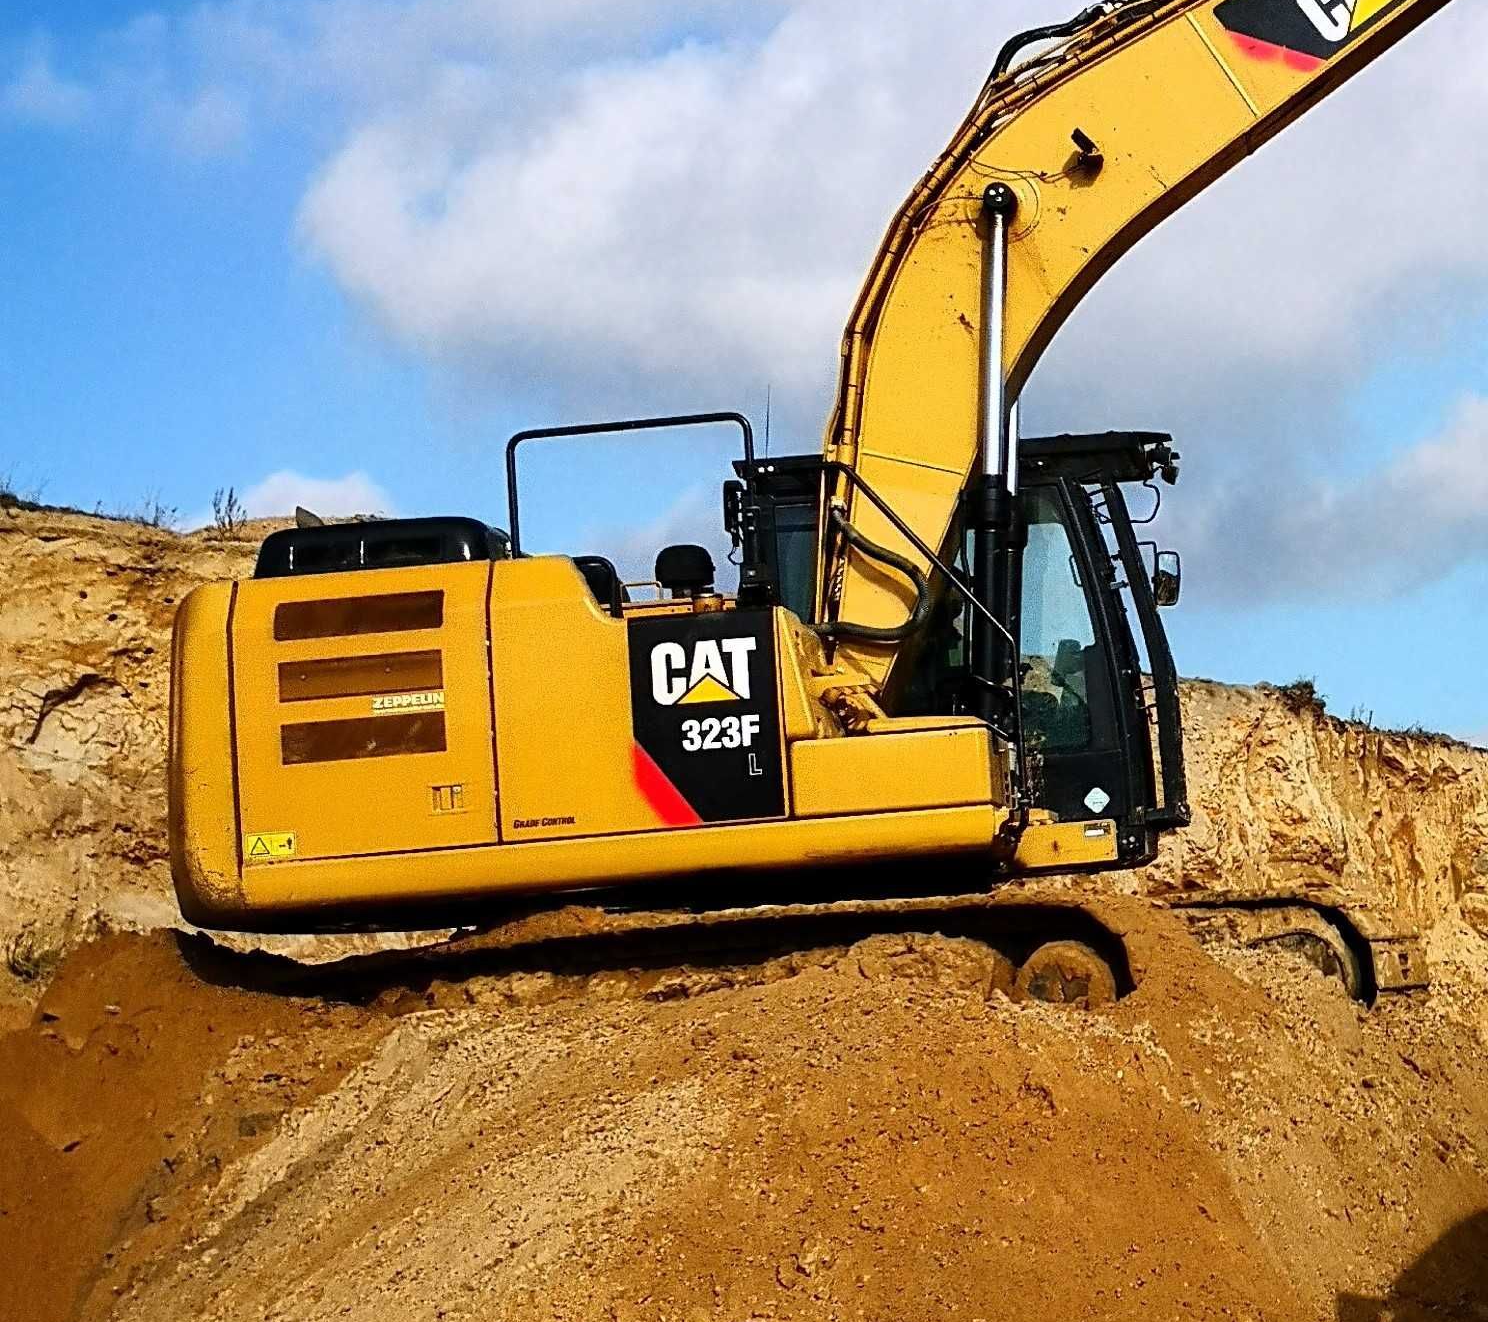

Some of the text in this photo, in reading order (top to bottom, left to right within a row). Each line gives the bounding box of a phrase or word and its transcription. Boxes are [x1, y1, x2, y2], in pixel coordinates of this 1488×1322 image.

[651, 637, 757, 706] CAT
[372, 692, 445, 709] ZEPPELIN
[682, 714, 760, 752] 323F
[748, 753, 763, 776] L
